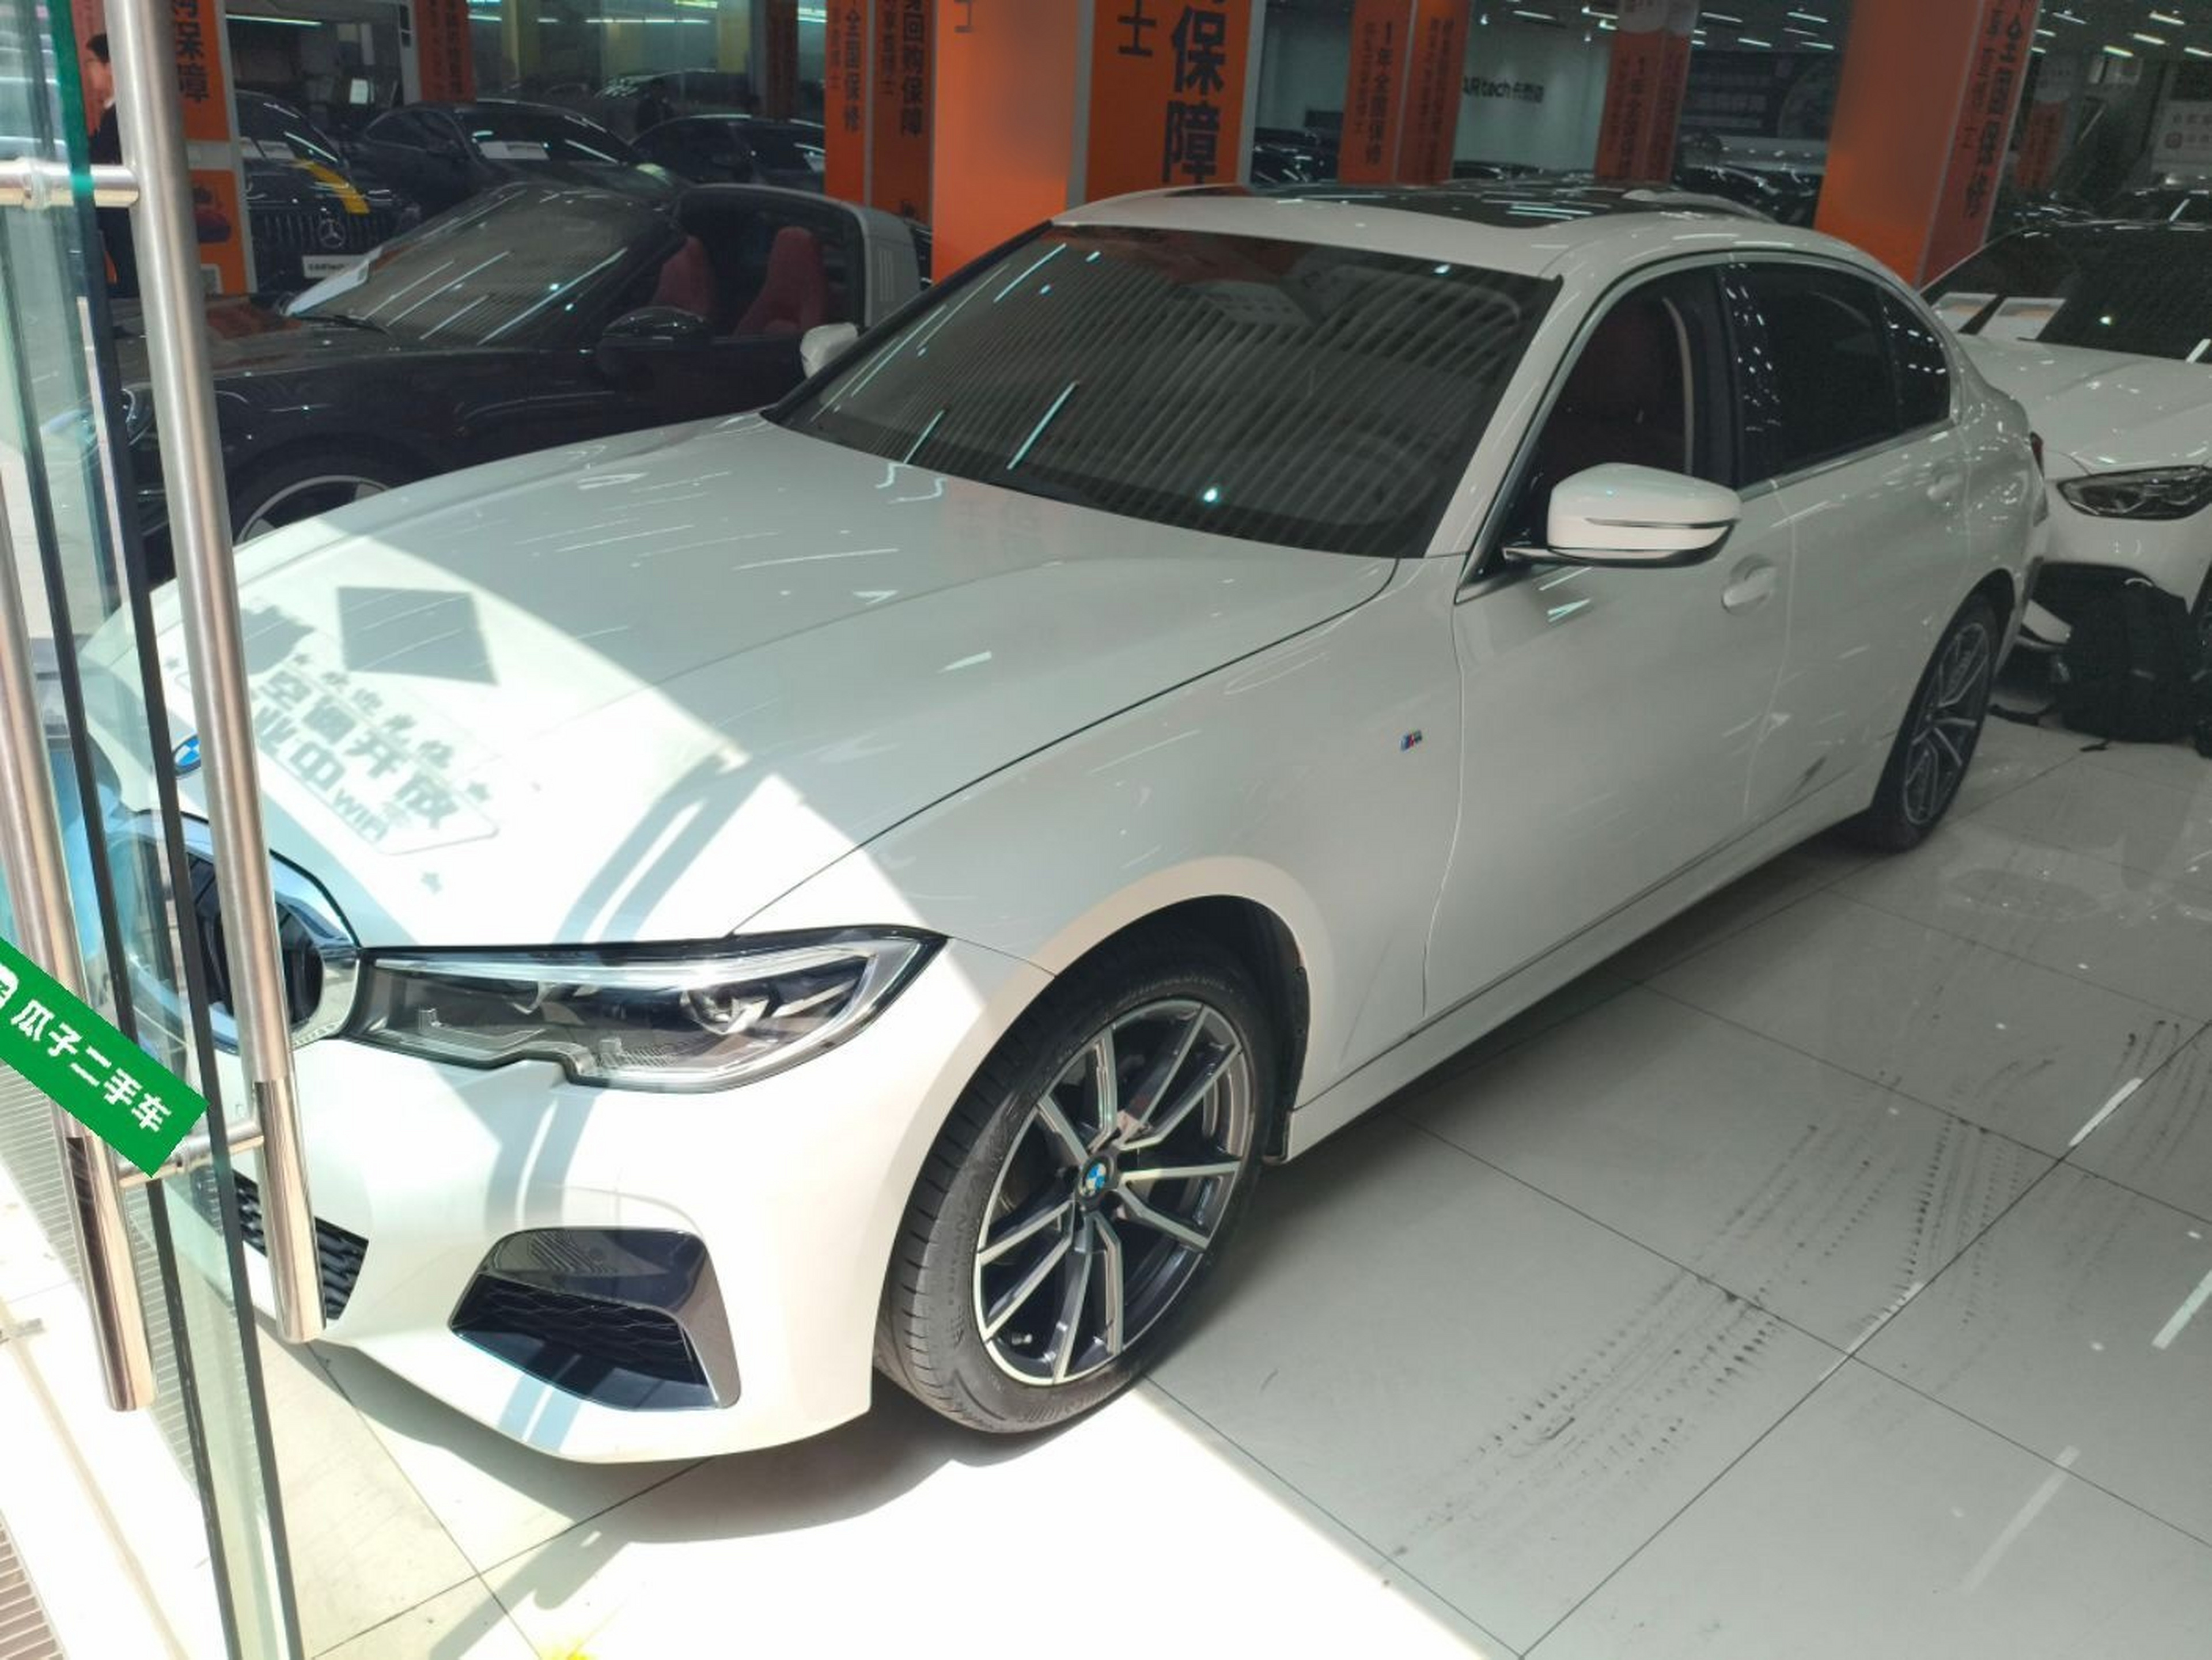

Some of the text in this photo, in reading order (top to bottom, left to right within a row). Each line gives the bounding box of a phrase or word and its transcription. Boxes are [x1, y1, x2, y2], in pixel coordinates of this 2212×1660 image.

[844, 0, 861, 133] 全国保修
[1162, 0, 1226, 184] 保障
[1964, 0, 2030, 218] 全国保修
